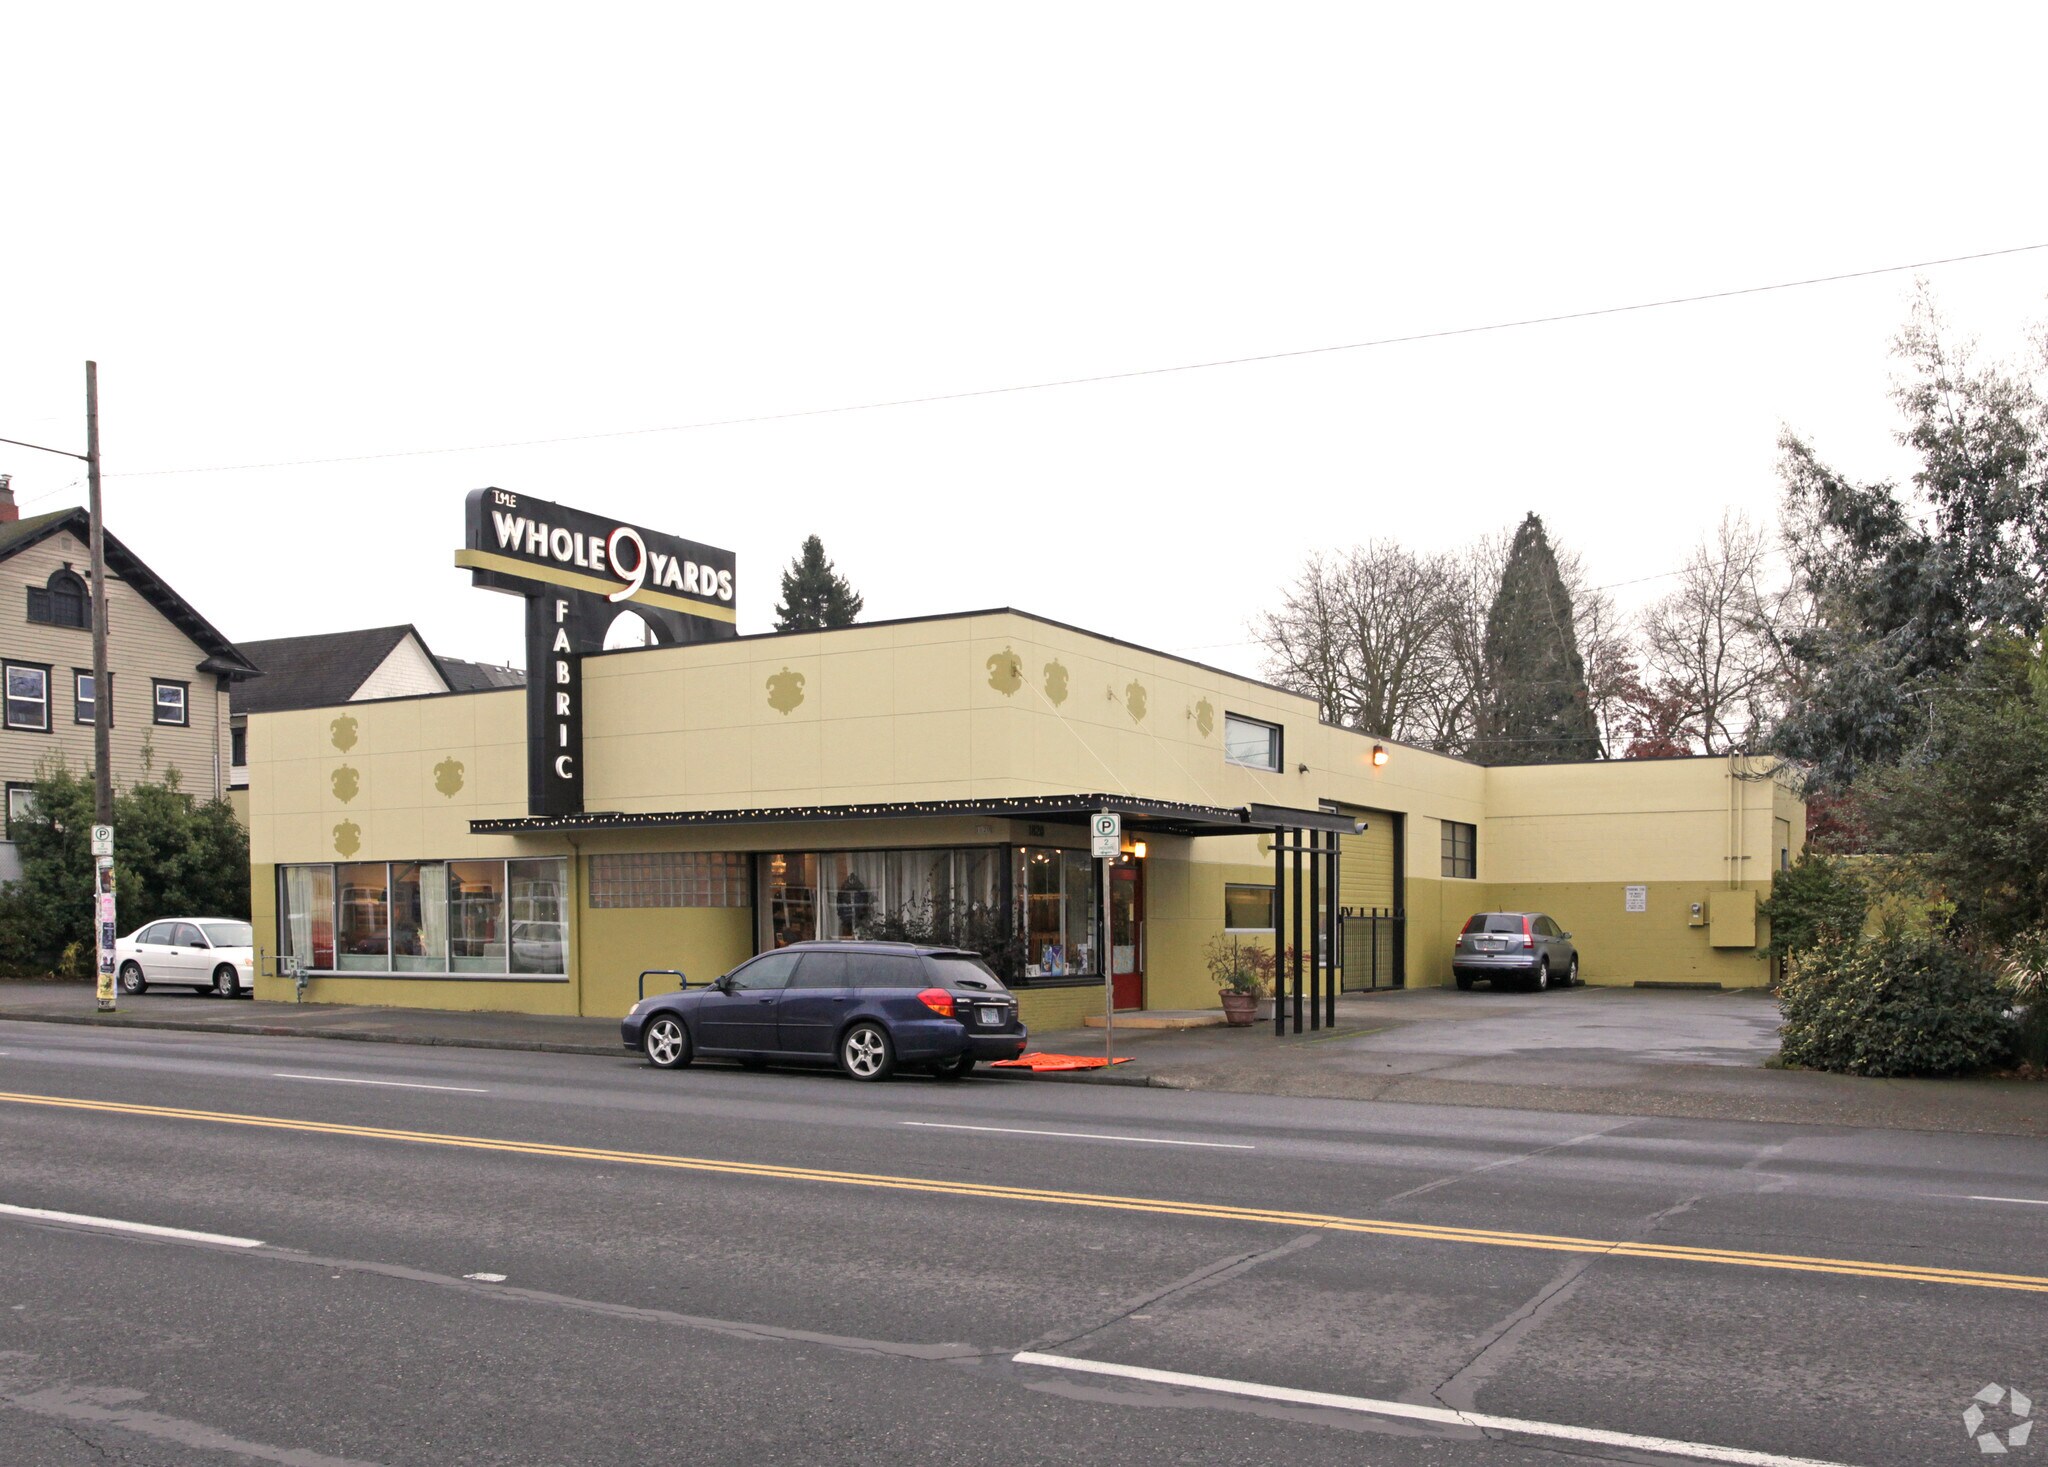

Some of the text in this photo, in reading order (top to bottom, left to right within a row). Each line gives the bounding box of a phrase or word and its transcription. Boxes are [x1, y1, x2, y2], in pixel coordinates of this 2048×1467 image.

[492, 490, 517, 508] THE
[491, 511, 733, 602] WHOLE 9 YARDS
[553, 599, 573, 779] FABRIC
[1101, 820, 1111, 832] P
[99, 830, 107, 838] P
[1103, 838, 1109, 846] 2
